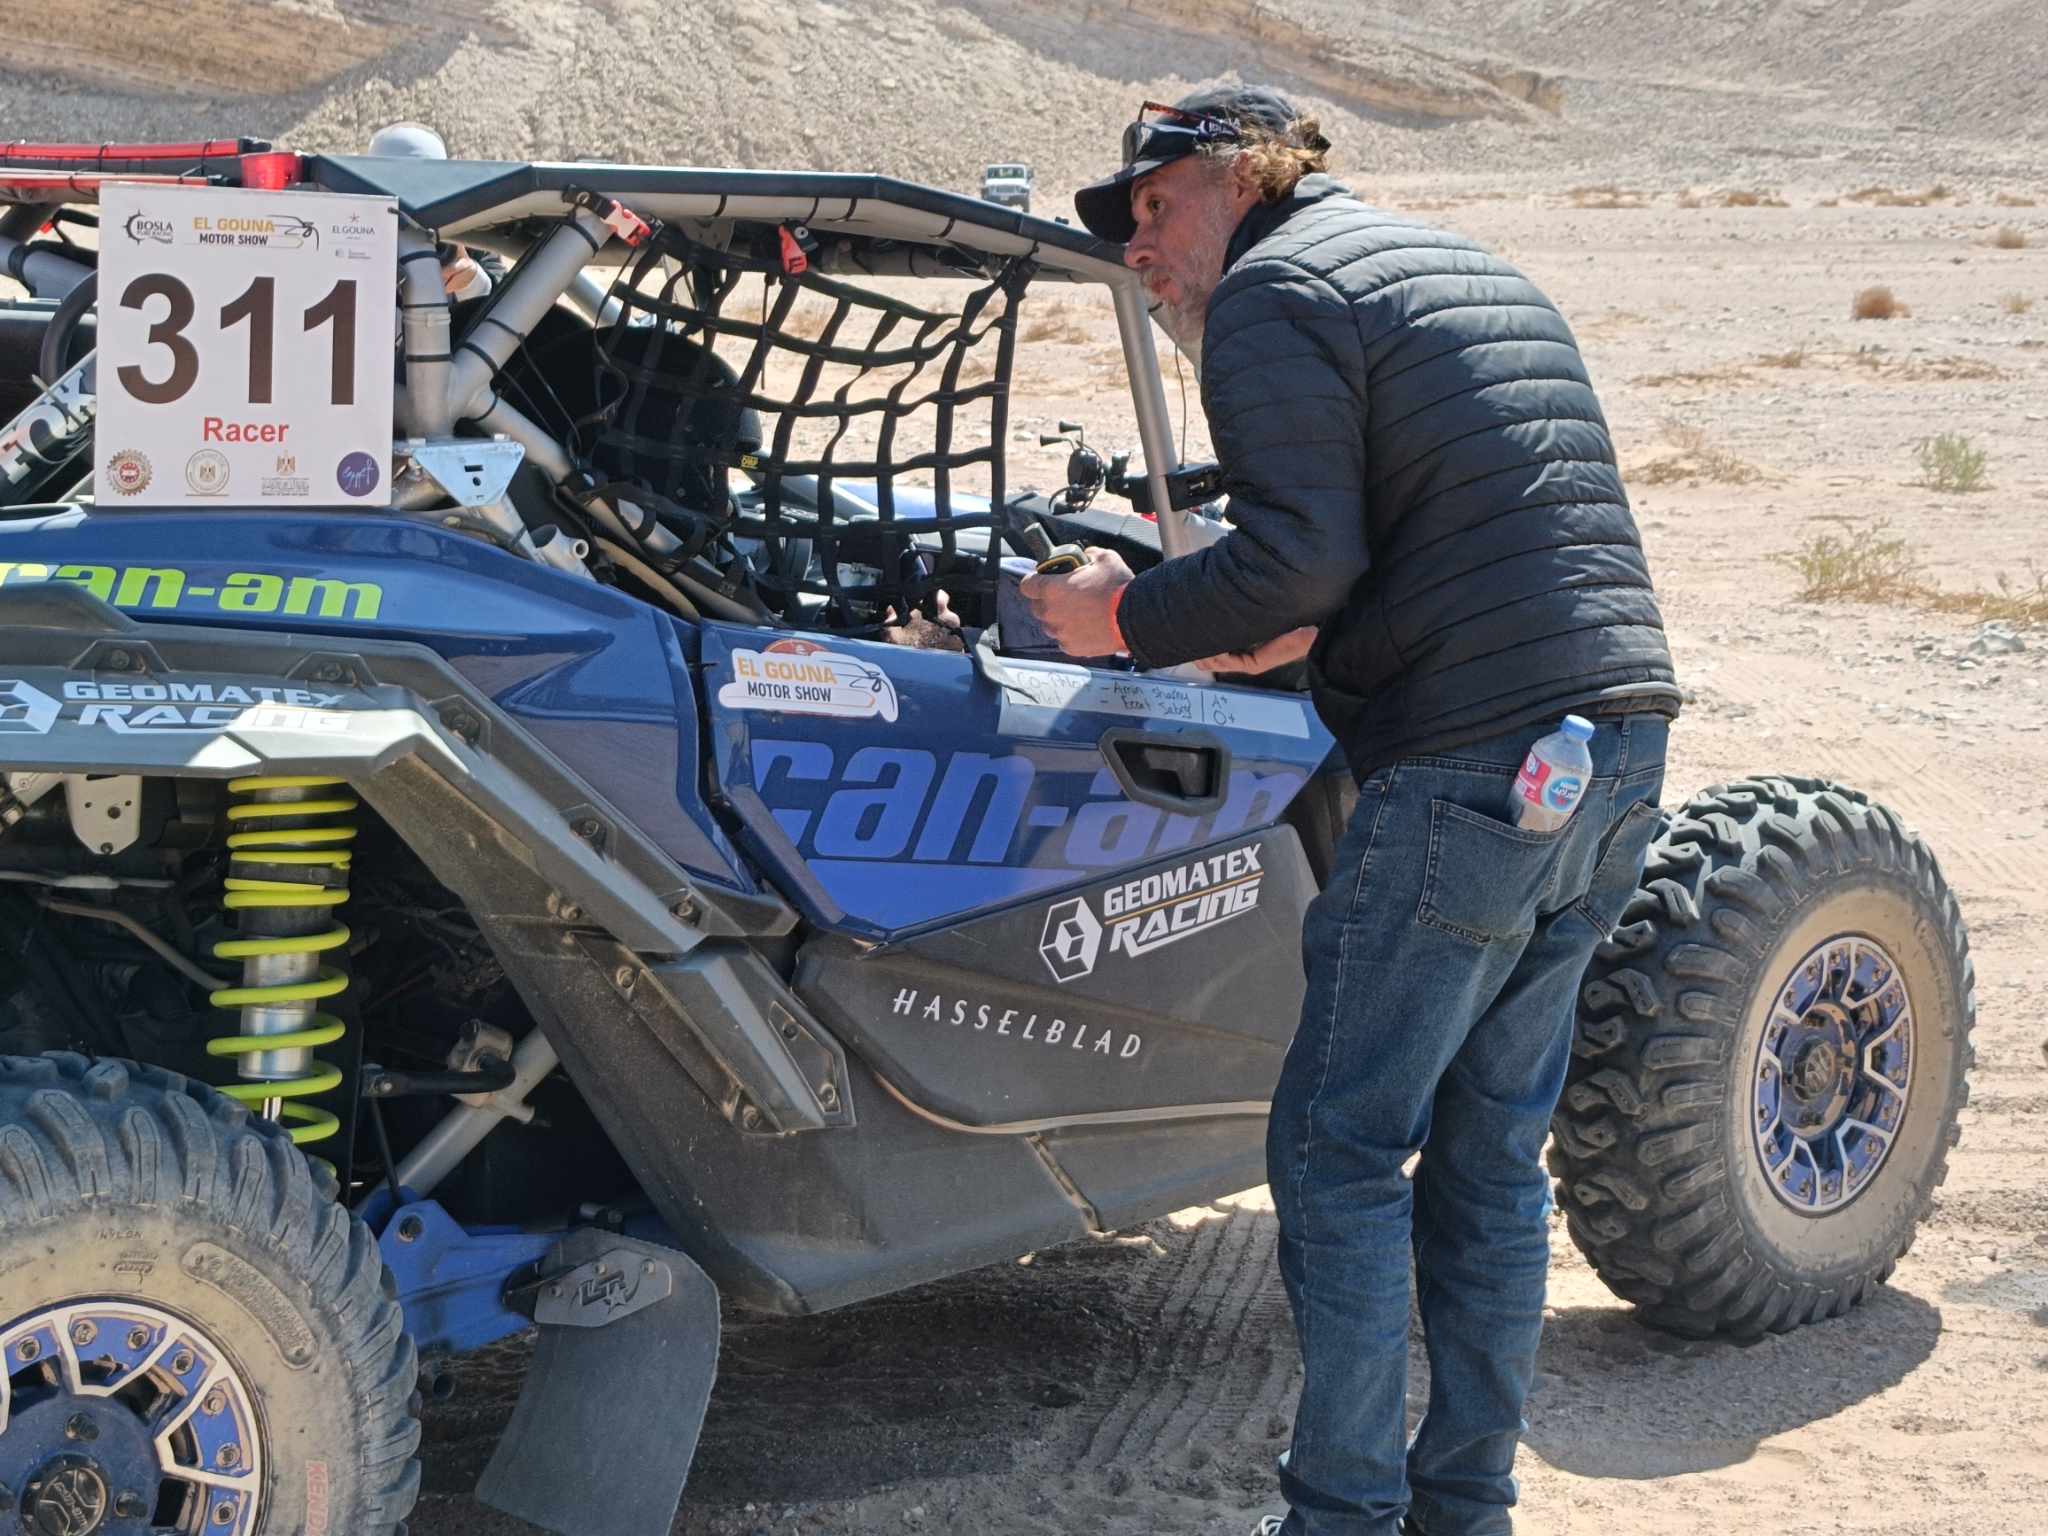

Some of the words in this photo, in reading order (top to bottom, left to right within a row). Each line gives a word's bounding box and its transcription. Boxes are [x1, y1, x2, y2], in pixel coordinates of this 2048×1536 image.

[136, 219, 174, 232] BOSLA
[193, 216, 210, 230] EL
[217, 216, 275, 233] GOUNA
[342, 225, 376, 235] GOUNA
[199, 233, 235, 246] MOTOR
[238, 234, 268, 247] SHOW
[117, 273, 357, 405] 311
[203, 416, 289, 443] Racer
[737, 656, 761, 678] EL
[764, 660, 838, 685] GOUNA
[62, 680, 346, 707] GEOMATEX
[747, 681, 792, 700] MOTOR
[795, 686, 832, 703] SHOW
[1103, 842, 1263, 917] GEOMATEX
[1109, 878, 1261, 958] RACING
[893, 988, 1142, 1058] HASSELBLAD
